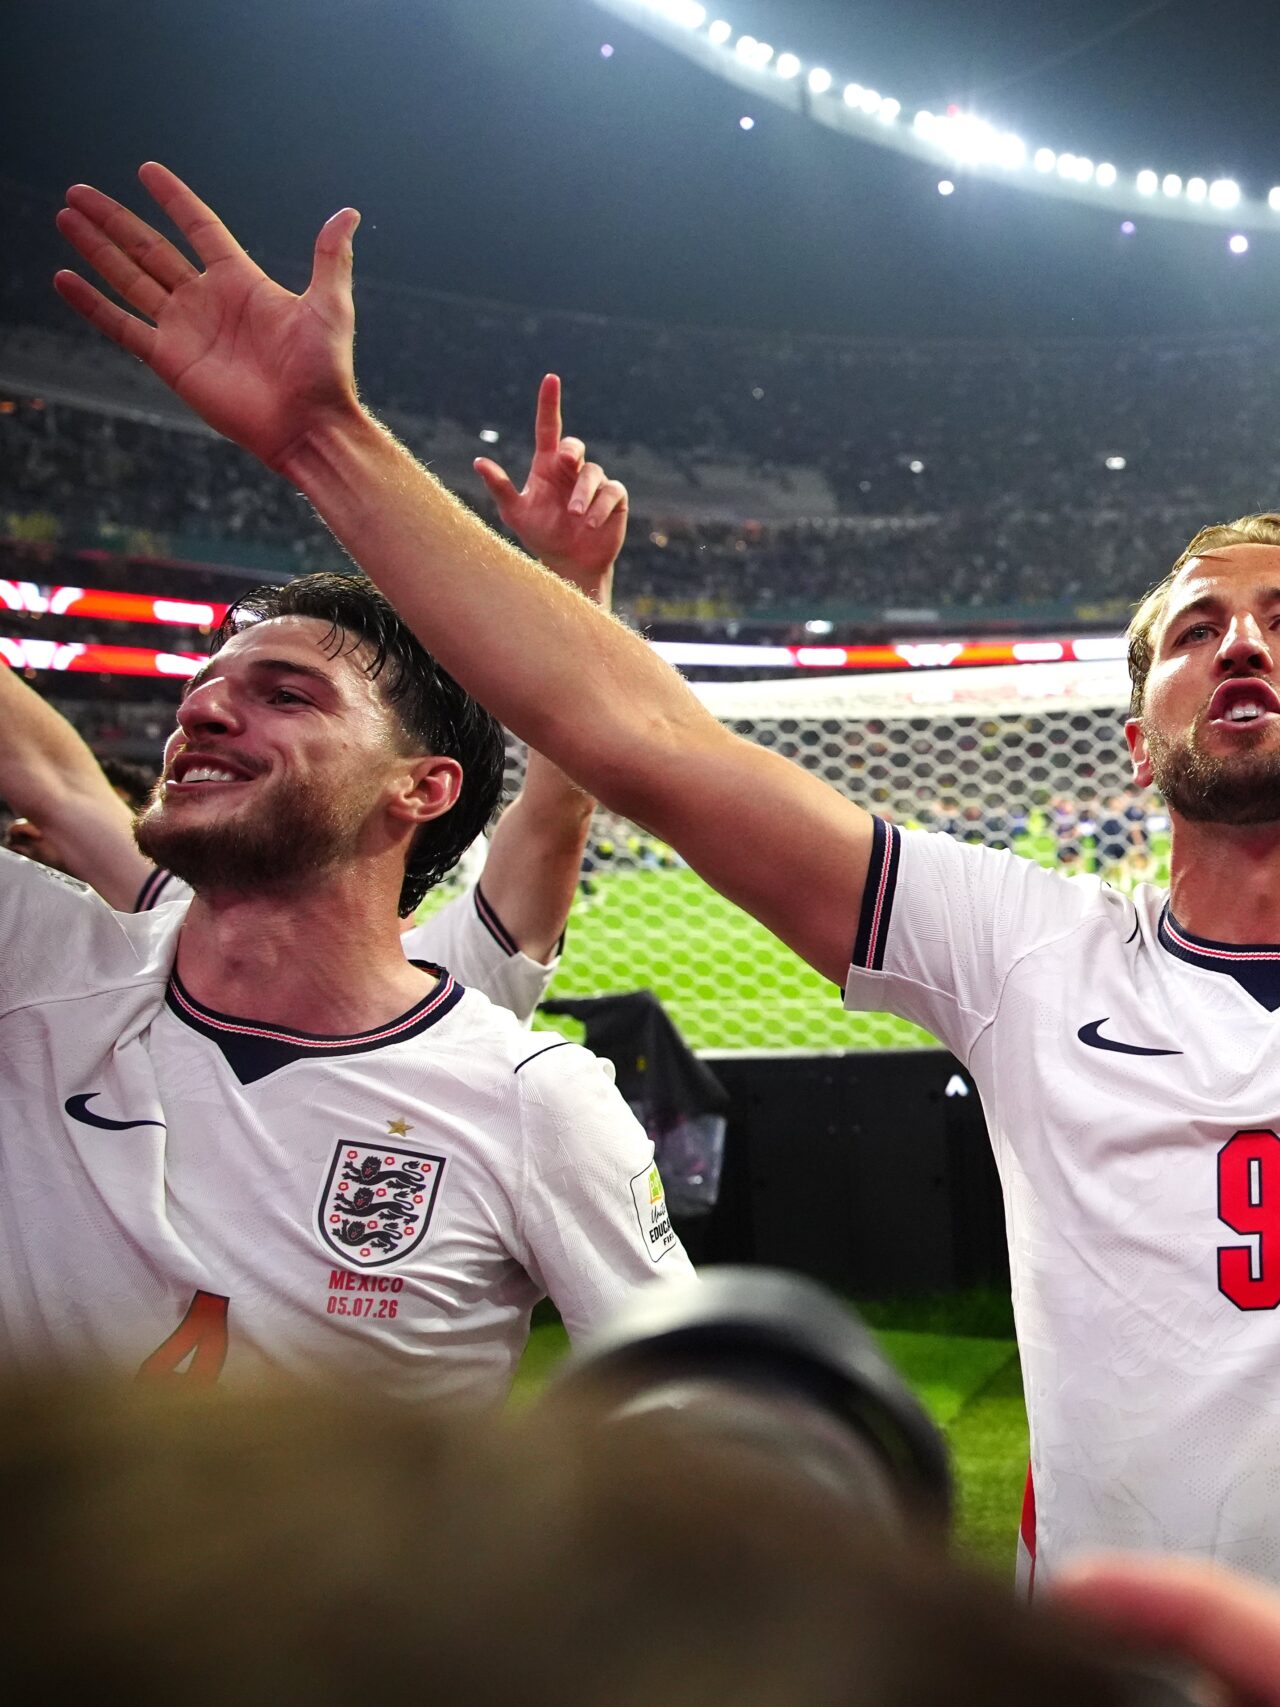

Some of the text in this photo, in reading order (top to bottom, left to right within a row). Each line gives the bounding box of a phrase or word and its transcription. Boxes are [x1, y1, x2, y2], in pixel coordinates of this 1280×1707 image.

[328, 1269, 404, 1293] MEXICO
[326, 1296, 399, 1318] 05.07.26
[134, 1289, 231, 1388] 4
